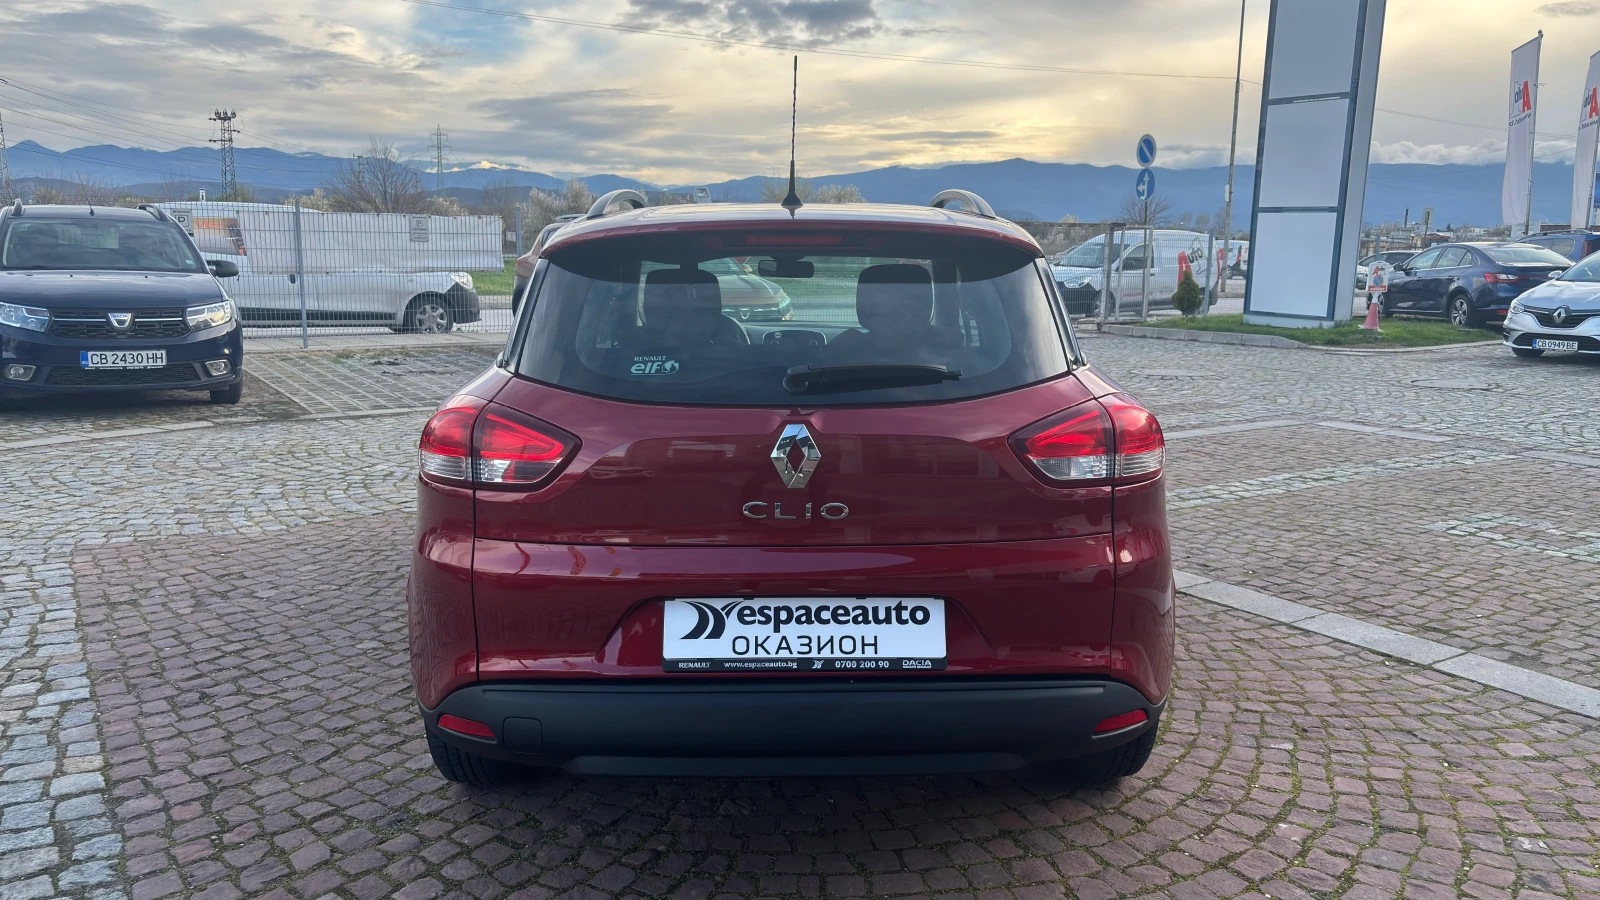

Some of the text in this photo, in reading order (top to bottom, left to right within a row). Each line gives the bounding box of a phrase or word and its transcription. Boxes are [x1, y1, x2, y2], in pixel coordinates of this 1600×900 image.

[90, 353, 109, 365] CB
[111, 352, 144, 365] 2430
[146, 352, 164, 364] HH
[630, 362, 662, 374] elf
[742, 501, 849, 520] CLIO
[736, 600, 931, 633] espaceauto
[731, 635, 878, 655] ОКАЗИОН
[724, 661, 798, 669] www.espaceauto.bg
[835, 660, 890, 668] 0700 200 90
